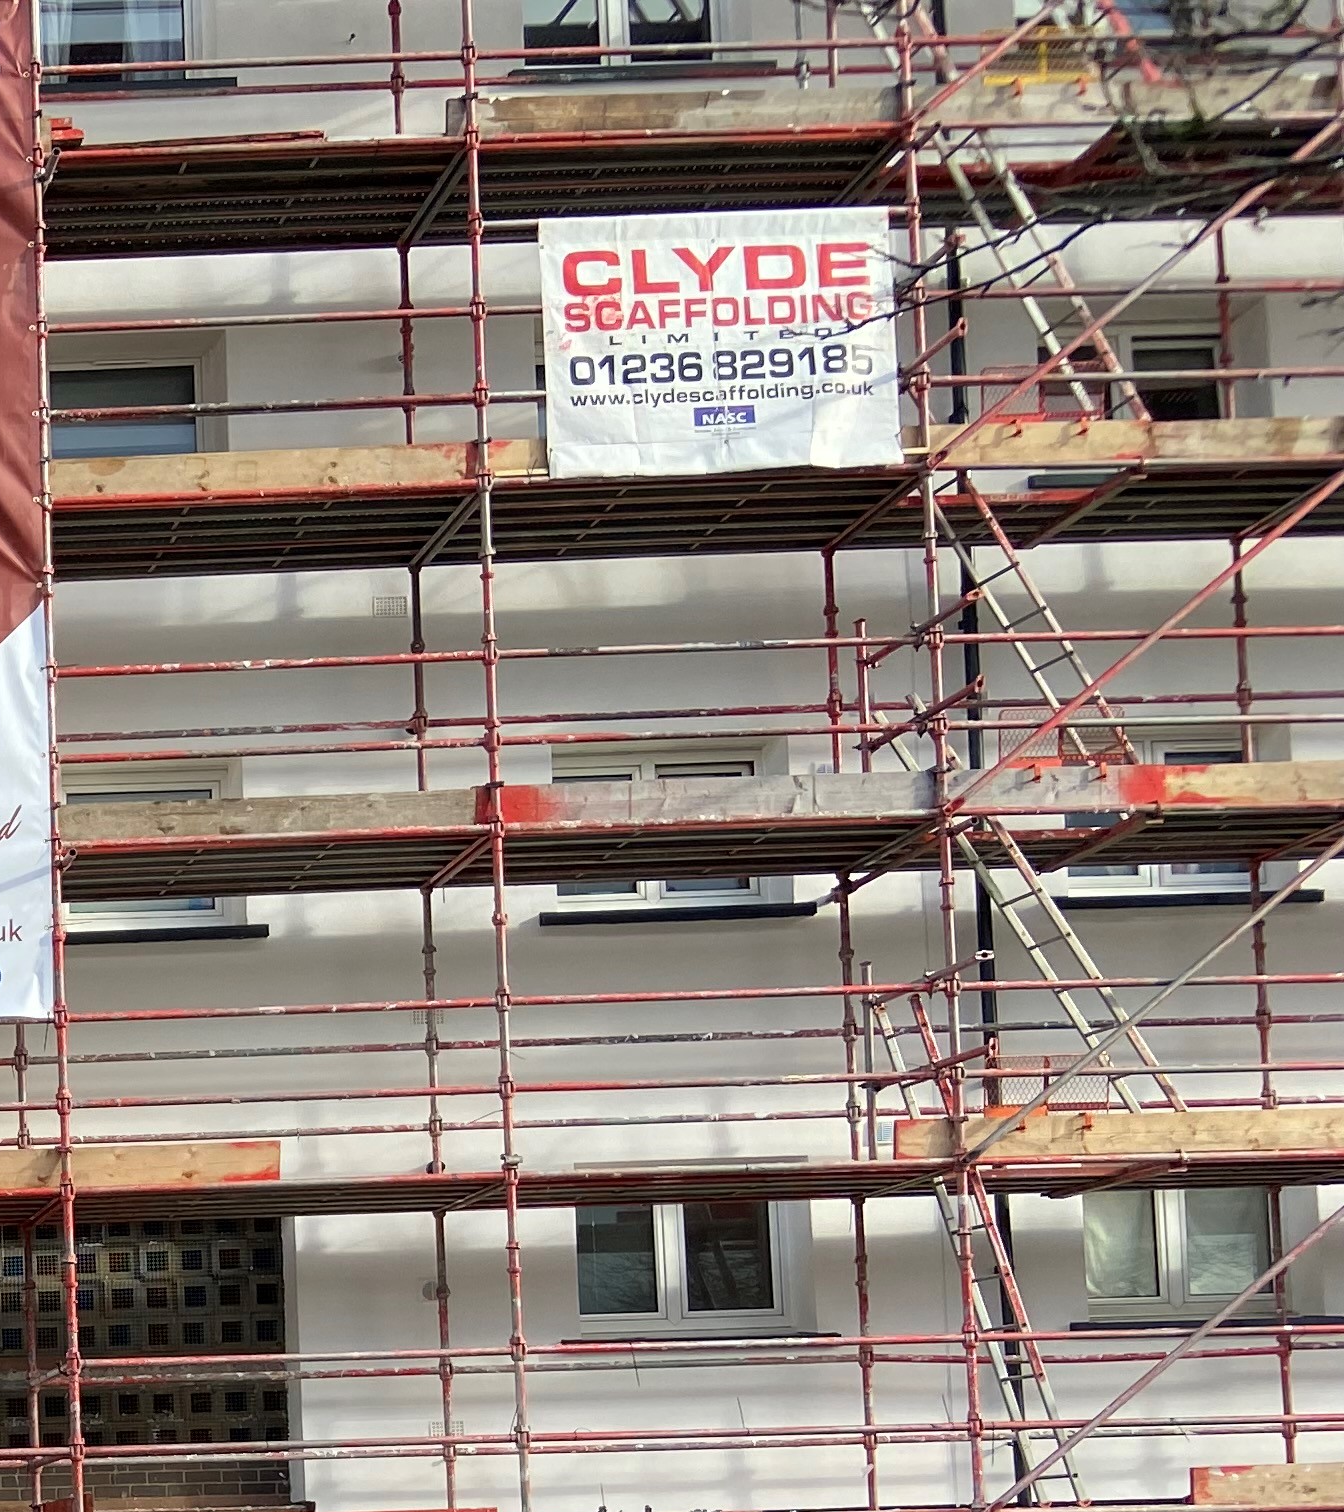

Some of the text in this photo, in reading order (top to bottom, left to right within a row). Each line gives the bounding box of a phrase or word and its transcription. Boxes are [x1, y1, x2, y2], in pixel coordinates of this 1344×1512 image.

[562, 242, 871, 296] CLYDE
[564, 291, 876, 333] SCAFFOLDING
[609, 329, 833, 346] LIMITED
[569, 344, 874, 386] 01236 829185
[570, 381, 874, 407] www.clydescaffolding.co.uk
[702, 412, 747, 425] NASC
